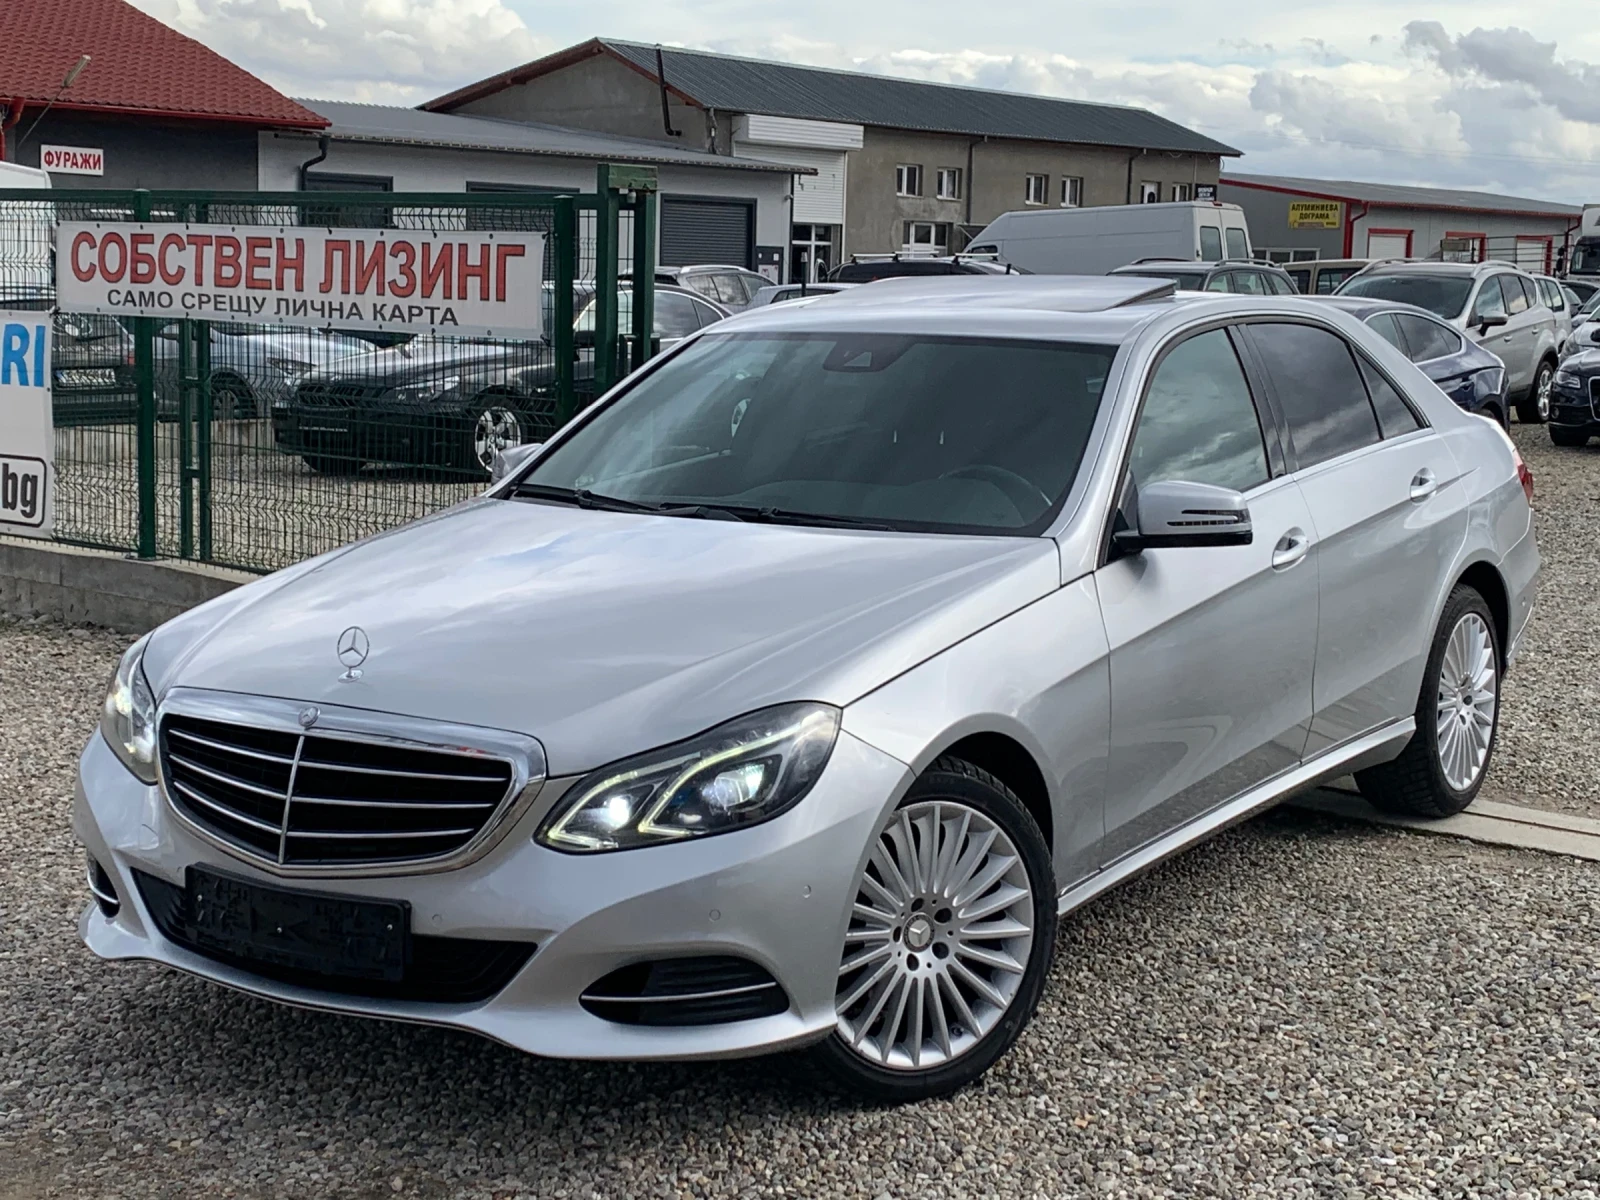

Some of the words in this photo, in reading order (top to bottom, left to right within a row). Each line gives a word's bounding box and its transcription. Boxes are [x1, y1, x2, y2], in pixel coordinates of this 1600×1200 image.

[44, 150, 101, 170] ФУРАЖИ
[1291, 203, 1339, 212] АЛУМИНИЕВА
[1299, 212, 1330, 220] ДОГРАМА
[71, 231, 305, 292] СОБСТВЕН
[319, 239, 526, 302] ЛИЗИНГ
[107, 289, 173, 309] САМО
[181, 292, 266, 317] СРЕЩУ
[274, 298, 364, 321] ЛИЧНА
[372, 303, 459, 326] КАРТА
[1, 323, 46, 388] RI
